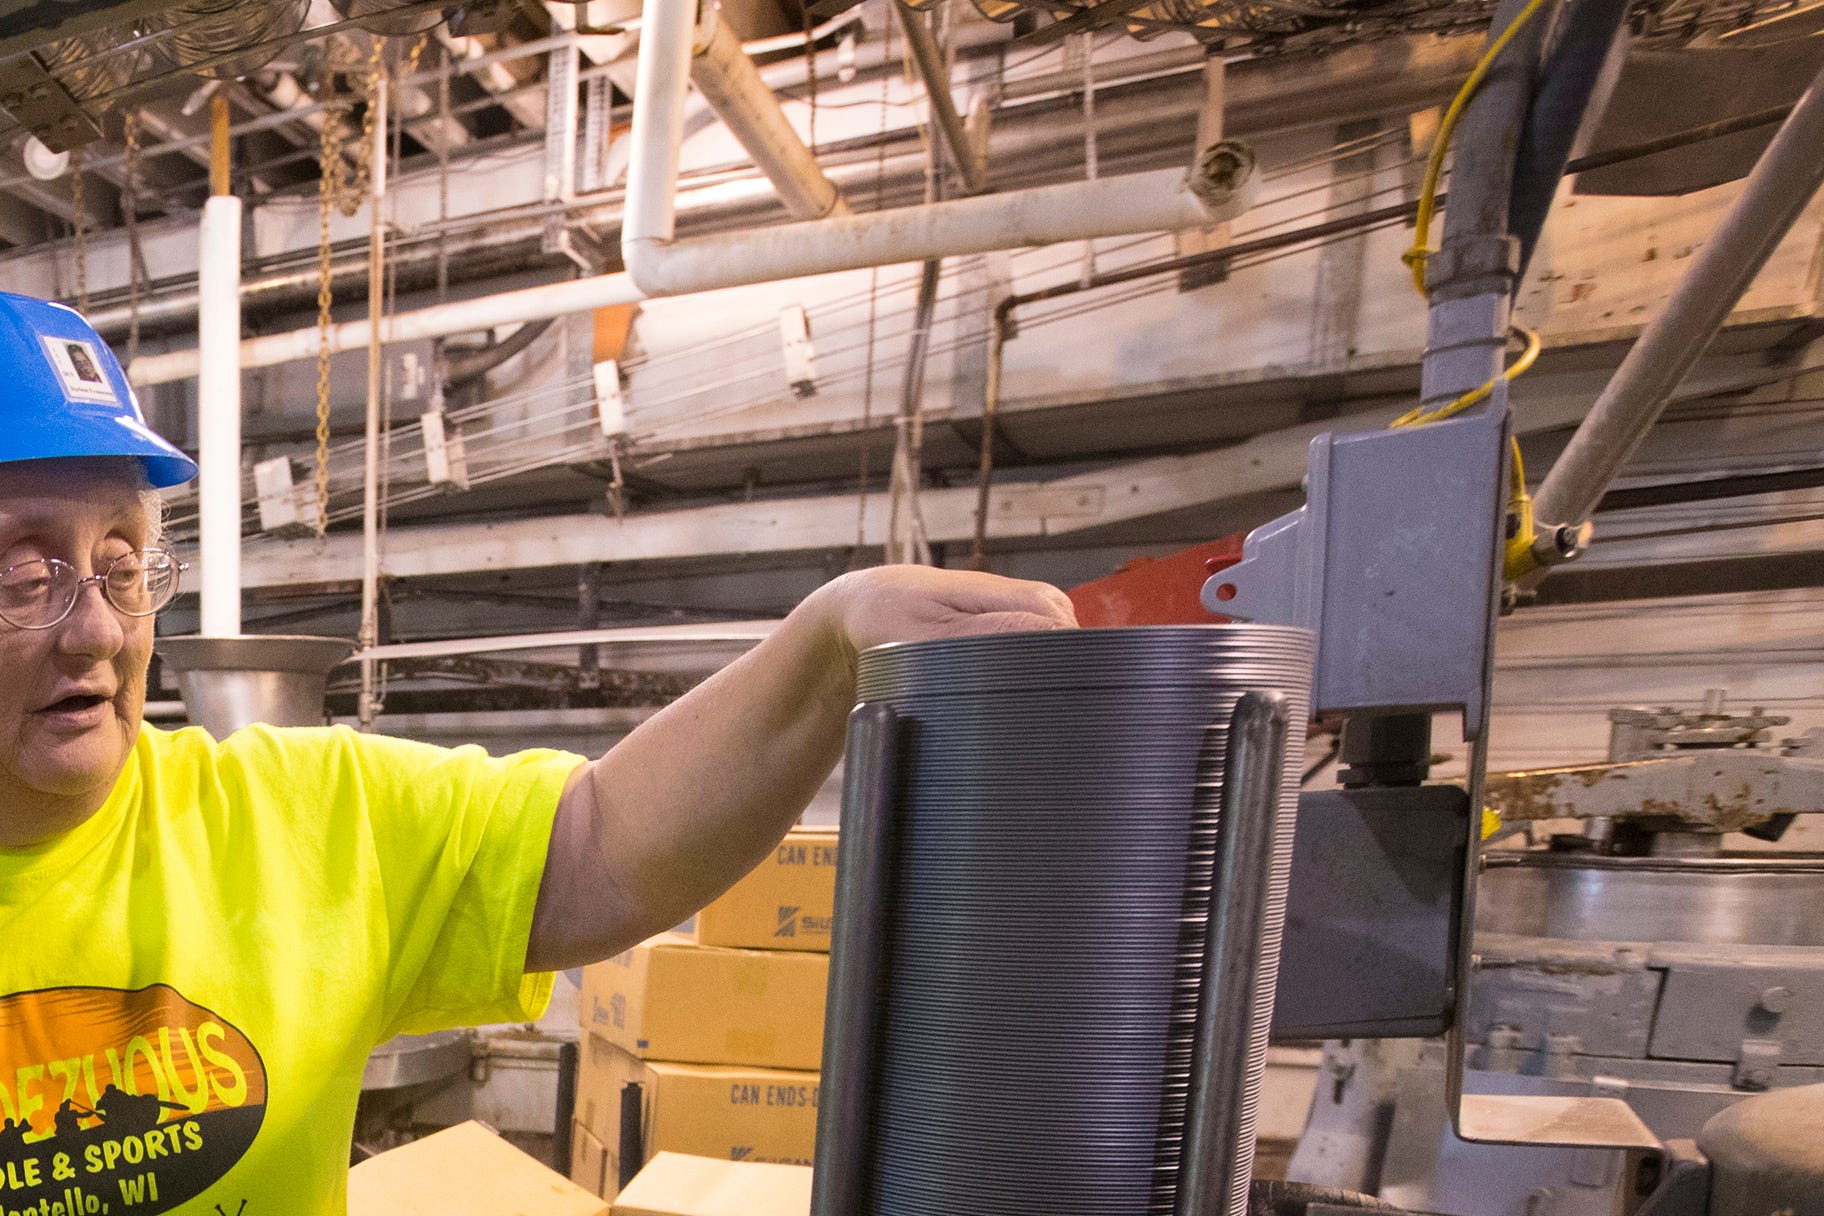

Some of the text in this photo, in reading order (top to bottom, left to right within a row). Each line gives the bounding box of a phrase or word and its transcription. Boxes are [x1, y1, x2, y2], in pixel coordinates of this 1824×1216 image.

[776, 845, 807, 865] CAN
[730, 1084, 760, 1105] CAN
[52, 1152, 76, 1182] &
[84, 1120, 204, 1174] SPORTS
[118, 1172, 159, 1207] WI
